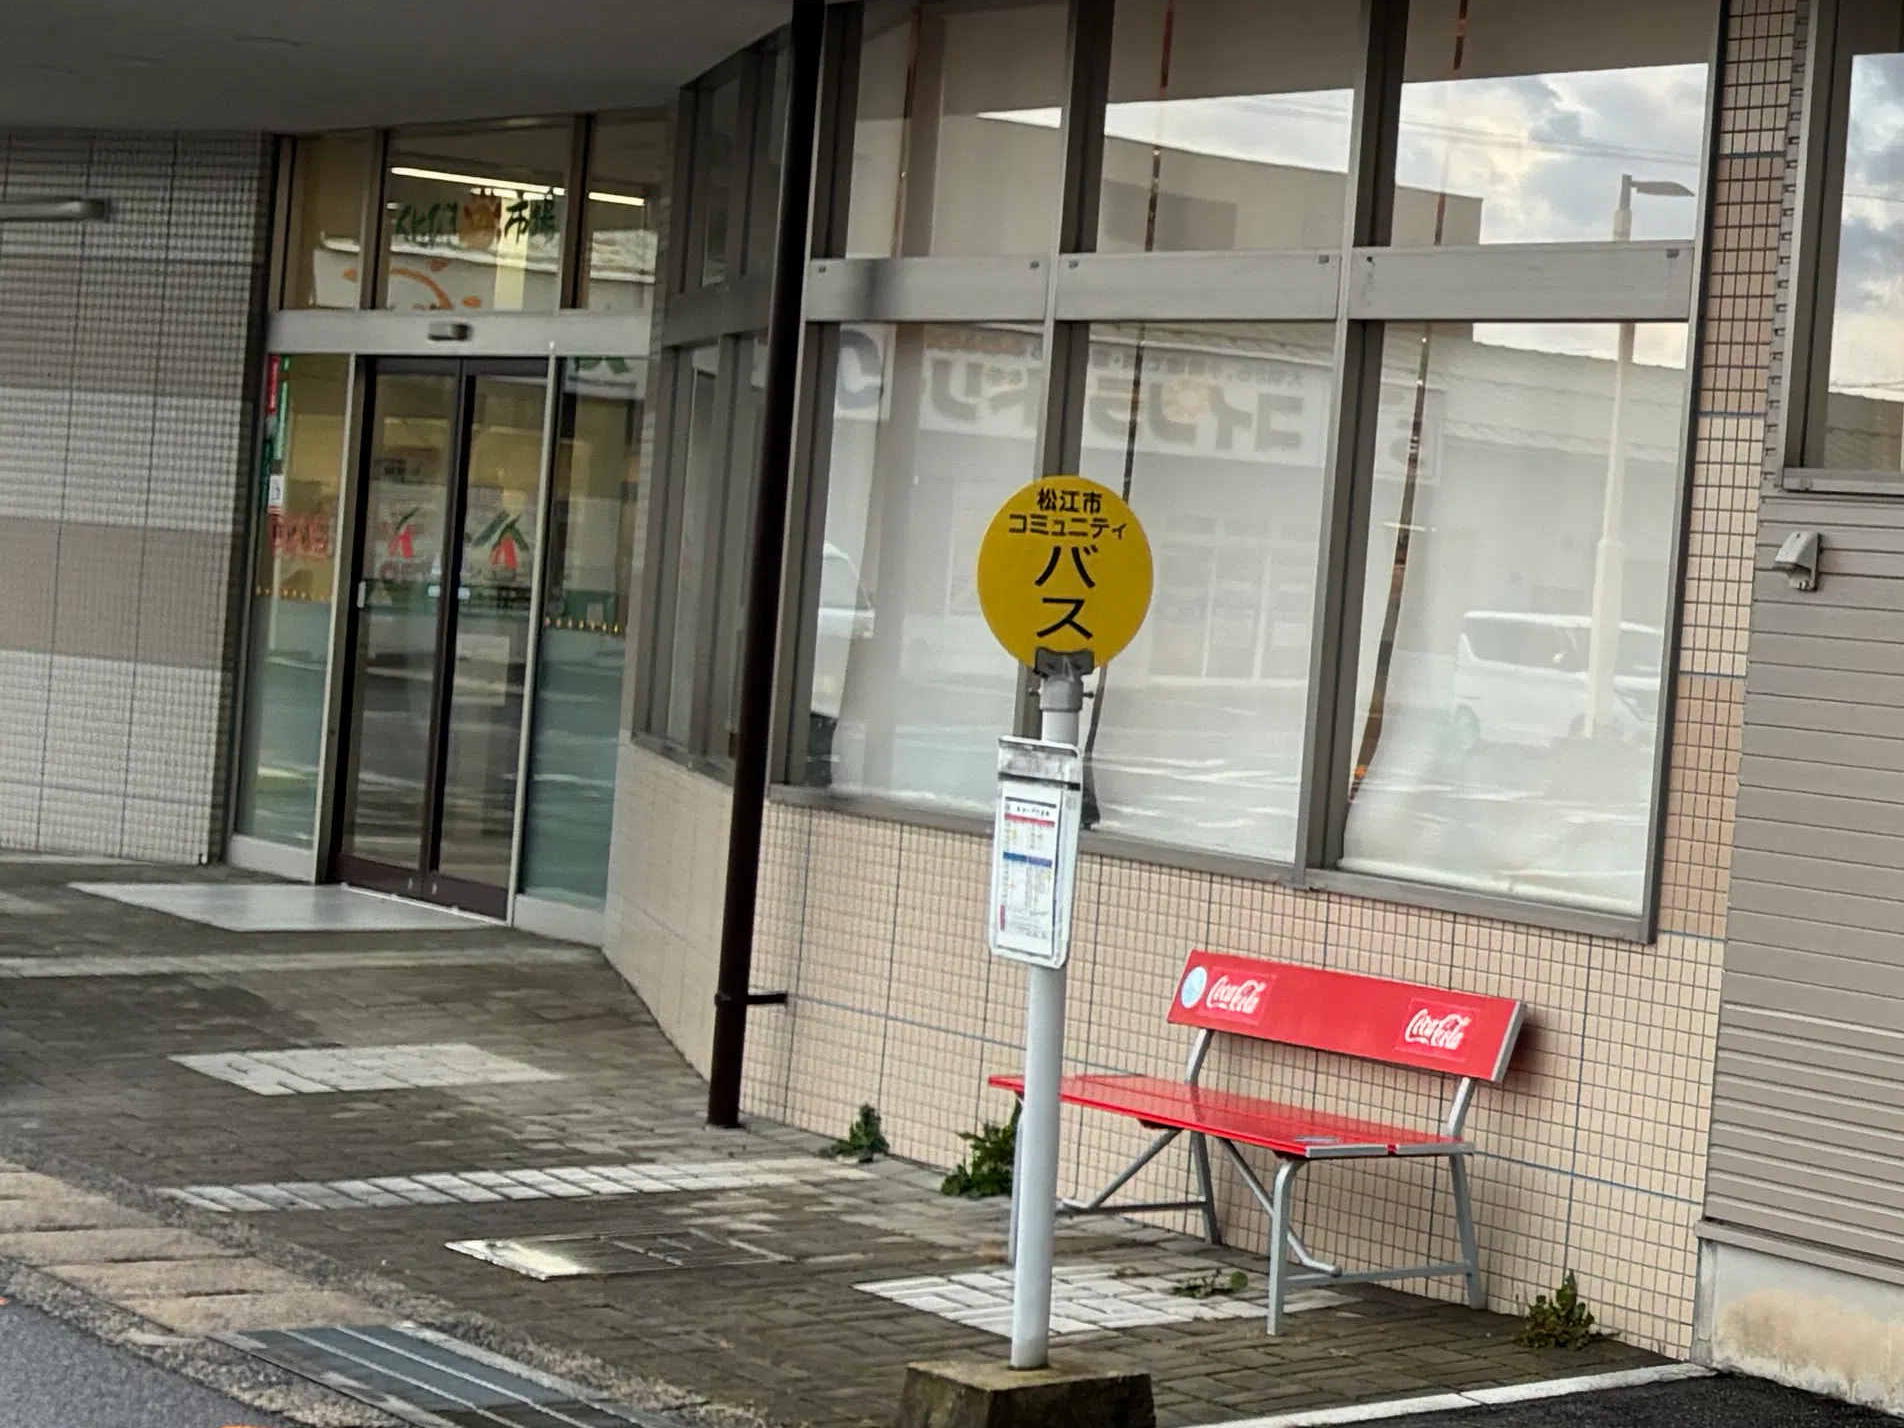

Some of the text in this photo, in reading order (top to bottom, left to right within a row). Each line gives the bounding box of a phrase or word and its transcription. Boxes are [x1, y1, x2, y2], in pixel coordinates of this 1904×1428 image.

[1036, 487, 1103, 514] 松江市
[1007, 512, 1129, 541] コミュニティ
[1033, 543, 1100, 641] バス
